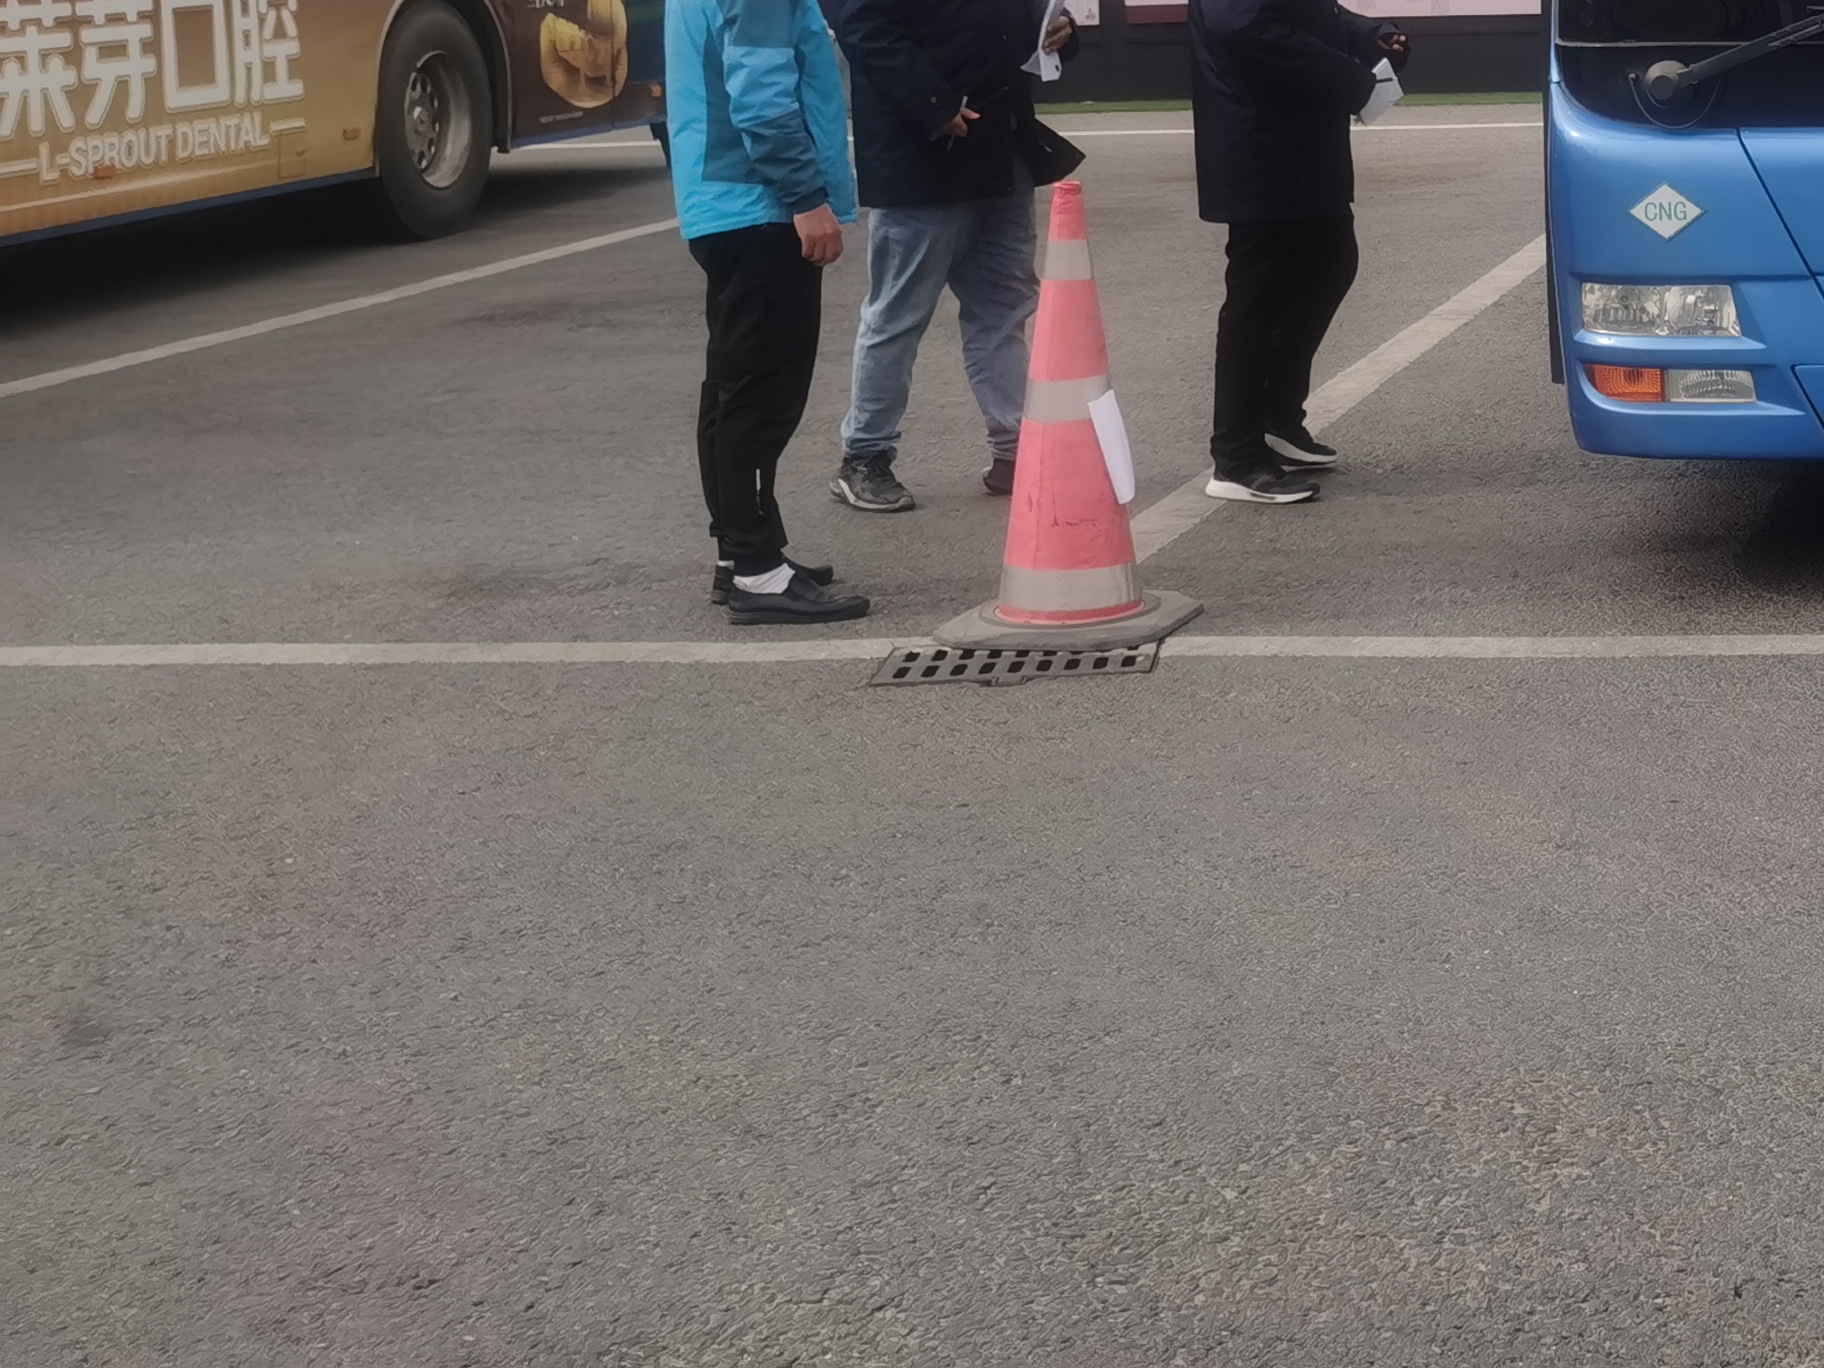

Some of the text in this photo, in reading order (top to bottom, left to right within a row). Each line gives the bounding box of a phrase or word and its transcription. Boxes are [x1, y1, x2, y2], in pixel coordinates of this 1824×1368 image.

[38, 110, 271, 185] L-SPROUT DENTAL
[1644, 200, 1688, 222] CNG
